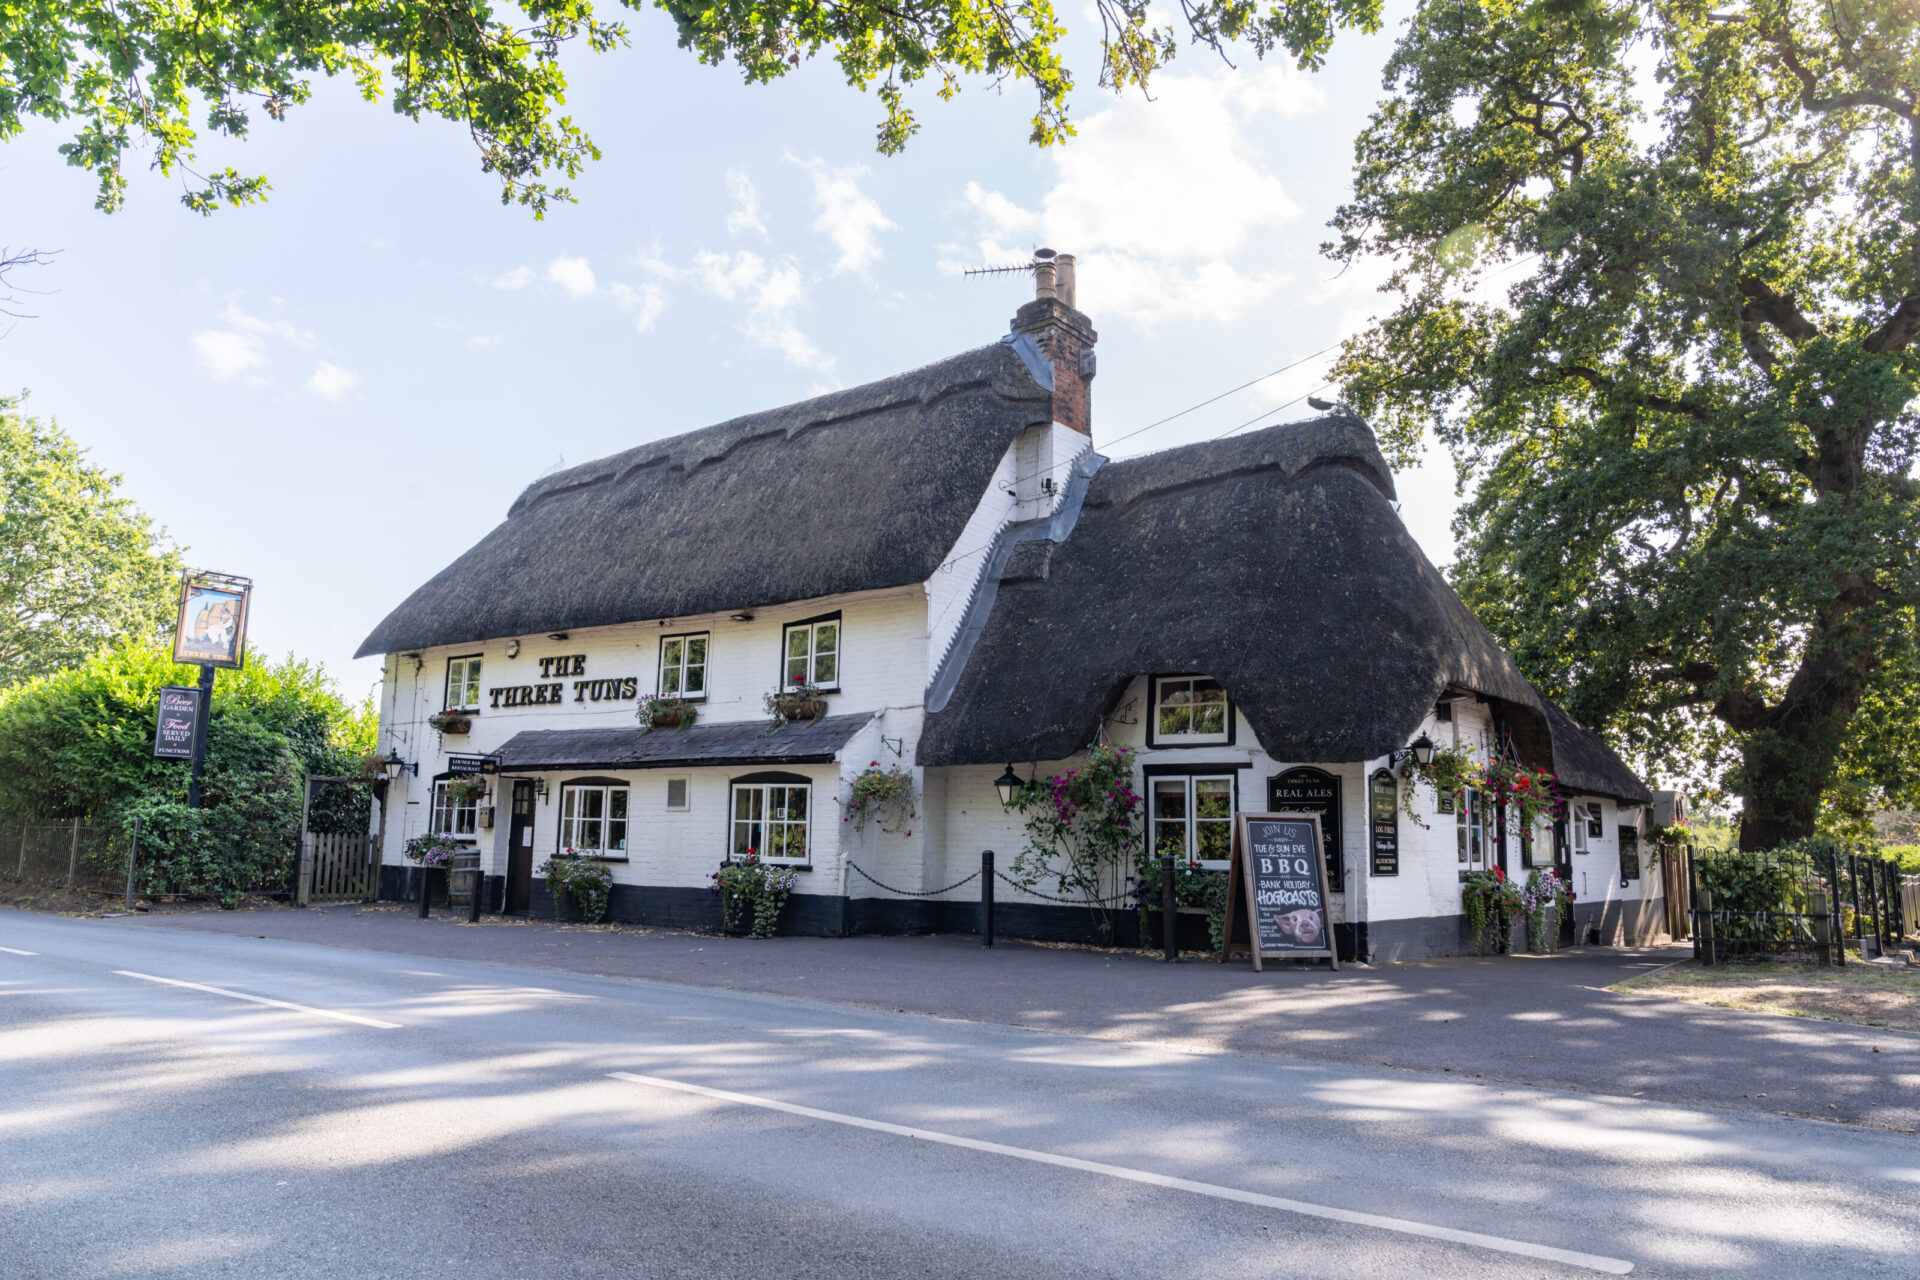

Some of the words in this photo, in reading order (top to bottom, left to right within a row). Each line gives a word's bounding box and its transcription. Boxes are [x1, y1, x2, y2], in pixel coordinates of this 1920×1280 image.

[183, 651, 209, 659] THREE
[212, 654, 232, 662] TUNS
[539, 654, 586, 679] THE
[490, 682, 563, 708] THREE
[573, 676, 638, 703] TUNS
[166, 694, 193, 705] Beer
[163, 704, 194, 712] GARDEN
[163, 718, 191, 730] Food
[1275, 788, 1303, 798] REAL
[1306, 788, 1333, 798] ALES
[1262, 824, 1281, 838] JOIN
[1284, 825, 1297, 838] US
[1254, 844, 1267, 853] TUE
[1276, 844, 1291, 853] SUN
[1292, 844, 1307, 854] EVE
[1260, 858, 1311, 876] BBQ
[1260, 880, 1281, 889] BANK
[1283, 880, 1311, 889] HOLIDAY
[1258, 889, 1319, 907] HOGROASTS
